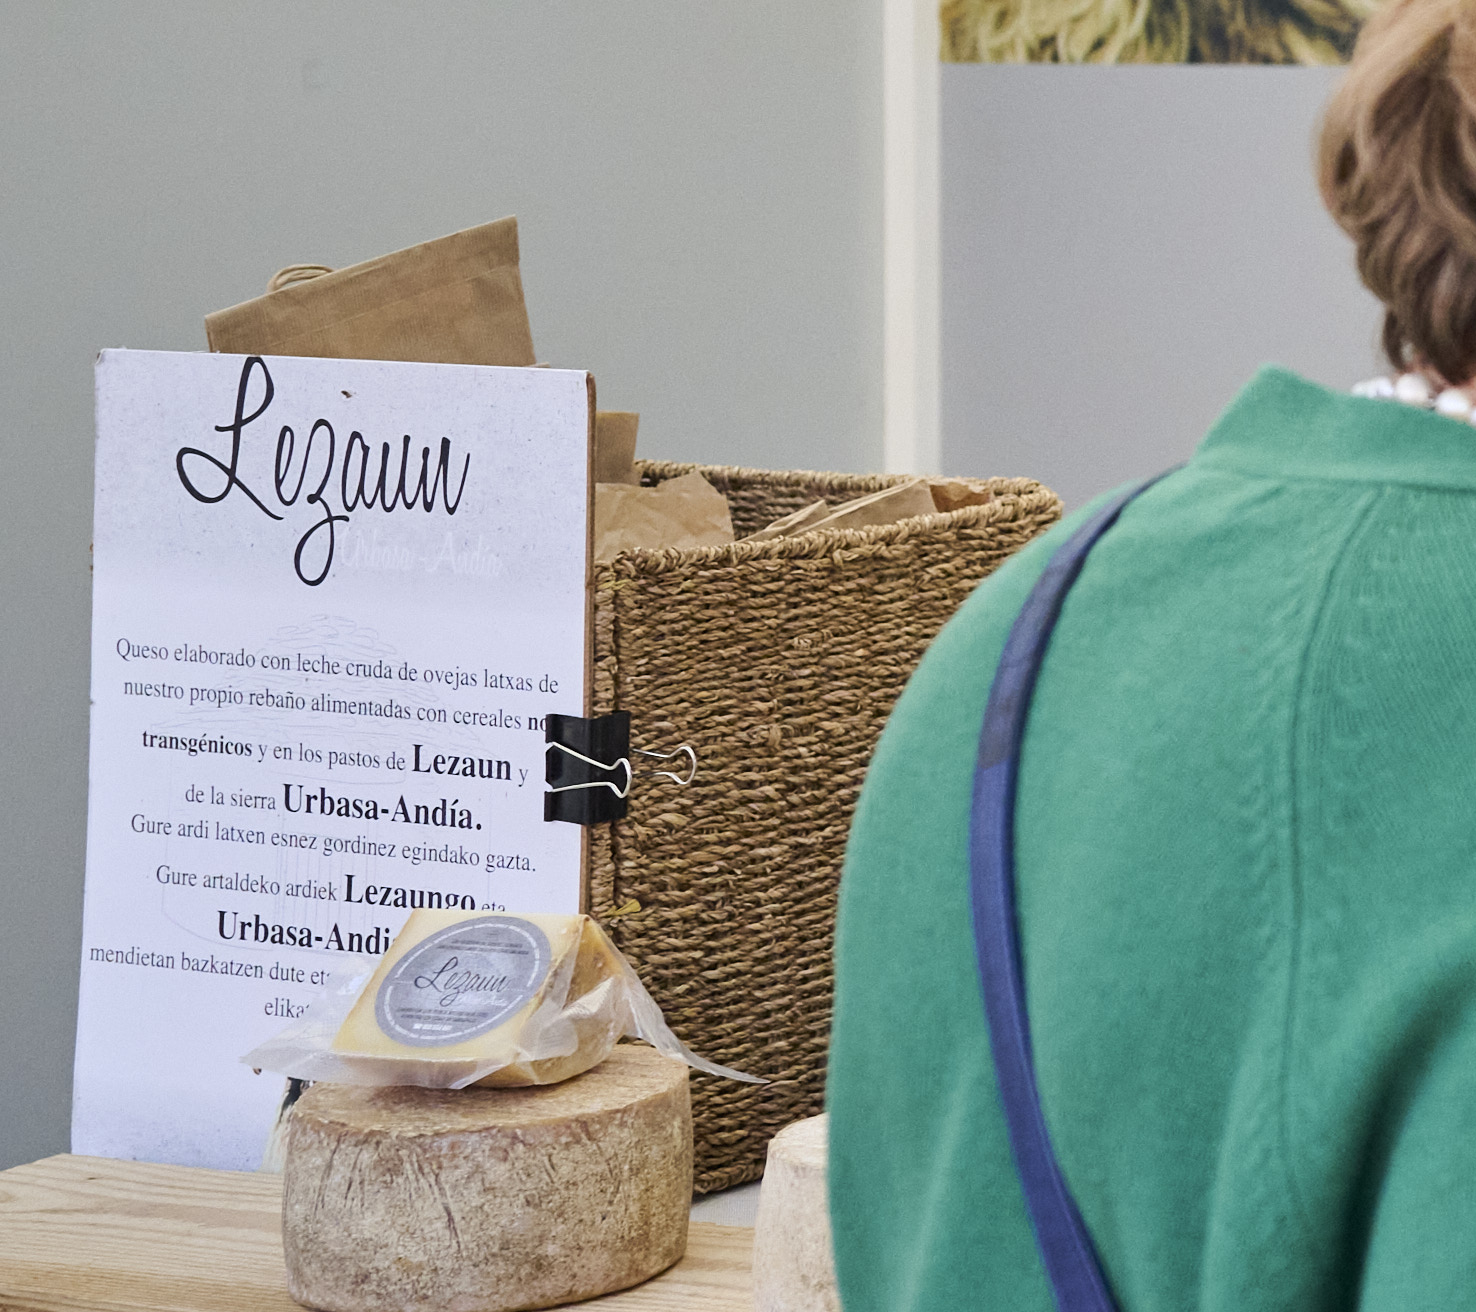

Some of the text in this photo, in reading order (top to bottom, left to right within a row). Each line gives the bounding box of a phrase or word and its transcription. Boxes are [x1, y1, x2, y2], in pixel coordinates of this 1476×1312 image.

[176, 356, 470, 586] Lezaun
[116, 638, 559, 694] Queso elaborado con leche cruda de ovejas latxas de
[124, 681, 184, 700] nuestro
[190, 685, 244, 708] propio
[249, 688, 306, 710] rebaño
[311, 692, 411, 720] alimentadas
[417, 706, 447, 723] con
[453, 709, 522, 730] cereales
[142, 730, 529, 787] transgénicos y en los pastos de Lezaun y
[185, 783, 482, 830] de la sierra Urbasa-Andía.
[131, 814, 536, 873] Gure ardi latxen esnez gordinez egindako gazta.
[156, 865, 197, 886] Gure
[203, 872, 280, 895] artaldeko
[285, 879, 337, 901] ardiek
[217, 910, 396, 955] Urbasa-Andi
[90, 946, 330, 985] mendietan bazkatzen dute et
[414, 956, 511, 1007] Lezaun
[264, 998, 310, 1019] elika
